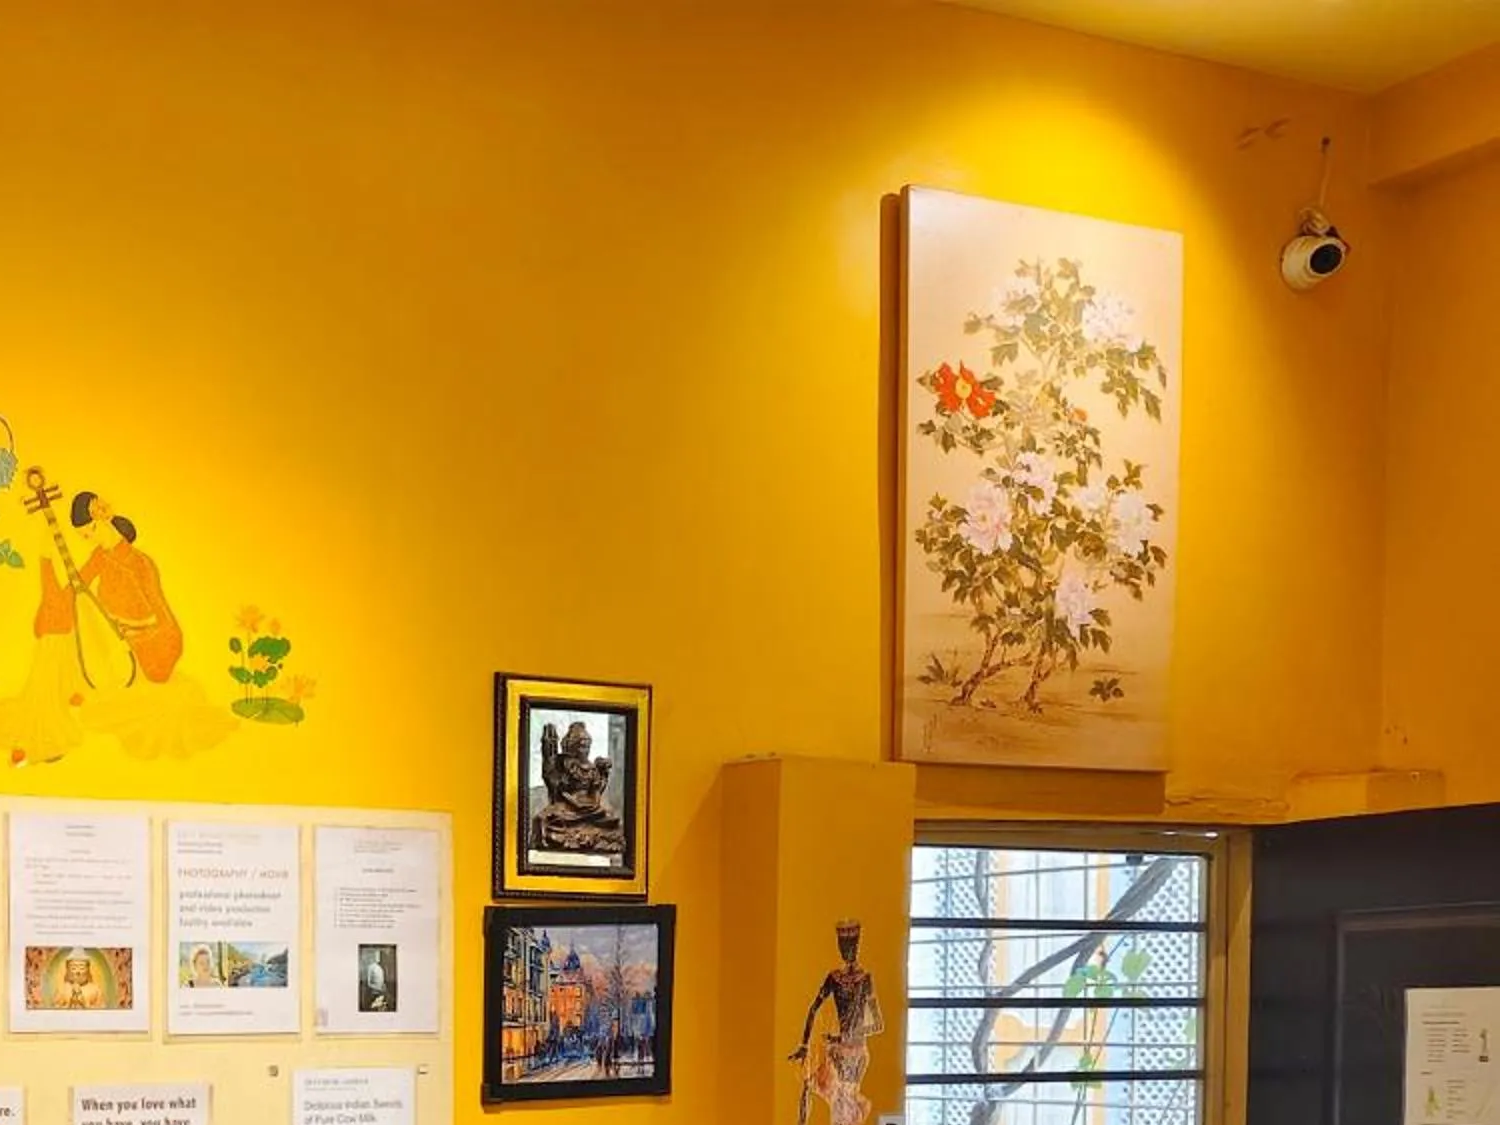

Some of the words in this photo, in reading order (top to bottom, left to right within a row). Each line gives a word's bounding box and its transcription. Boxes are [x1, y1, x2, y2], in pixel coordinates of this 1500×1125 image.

[81, 1098, 114, 1112] When
[116, 1100, 138, 1115] you
[140, 1097, 165, 1111] love
[168, 1097, 197, 1109] what
